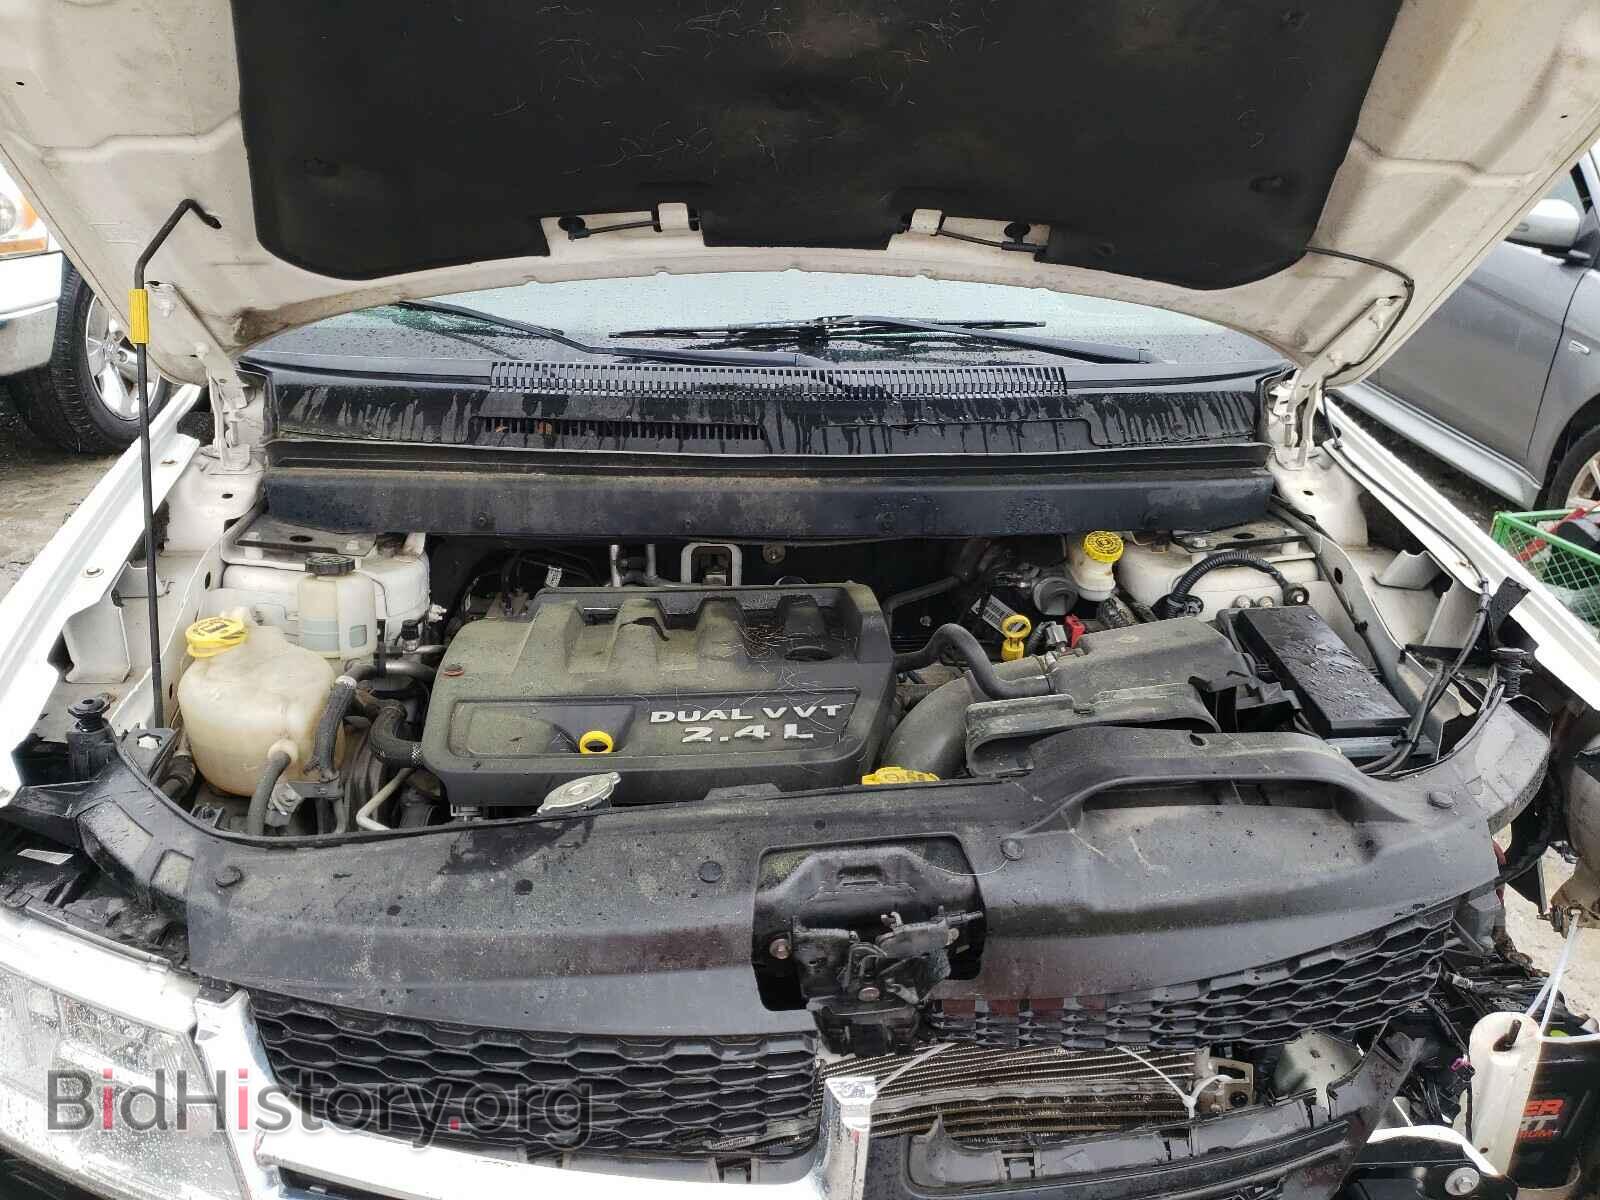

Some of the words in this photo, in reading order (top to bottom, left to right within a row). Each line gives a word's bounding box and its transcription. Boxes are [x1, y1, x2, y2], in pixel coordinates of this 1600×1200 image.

[650, 708, 754, 723] DUAL
[762, 705, 842, 718] VVT
[682, 725, 771, 743] 2.4
[783, 723, 814, 739] L
